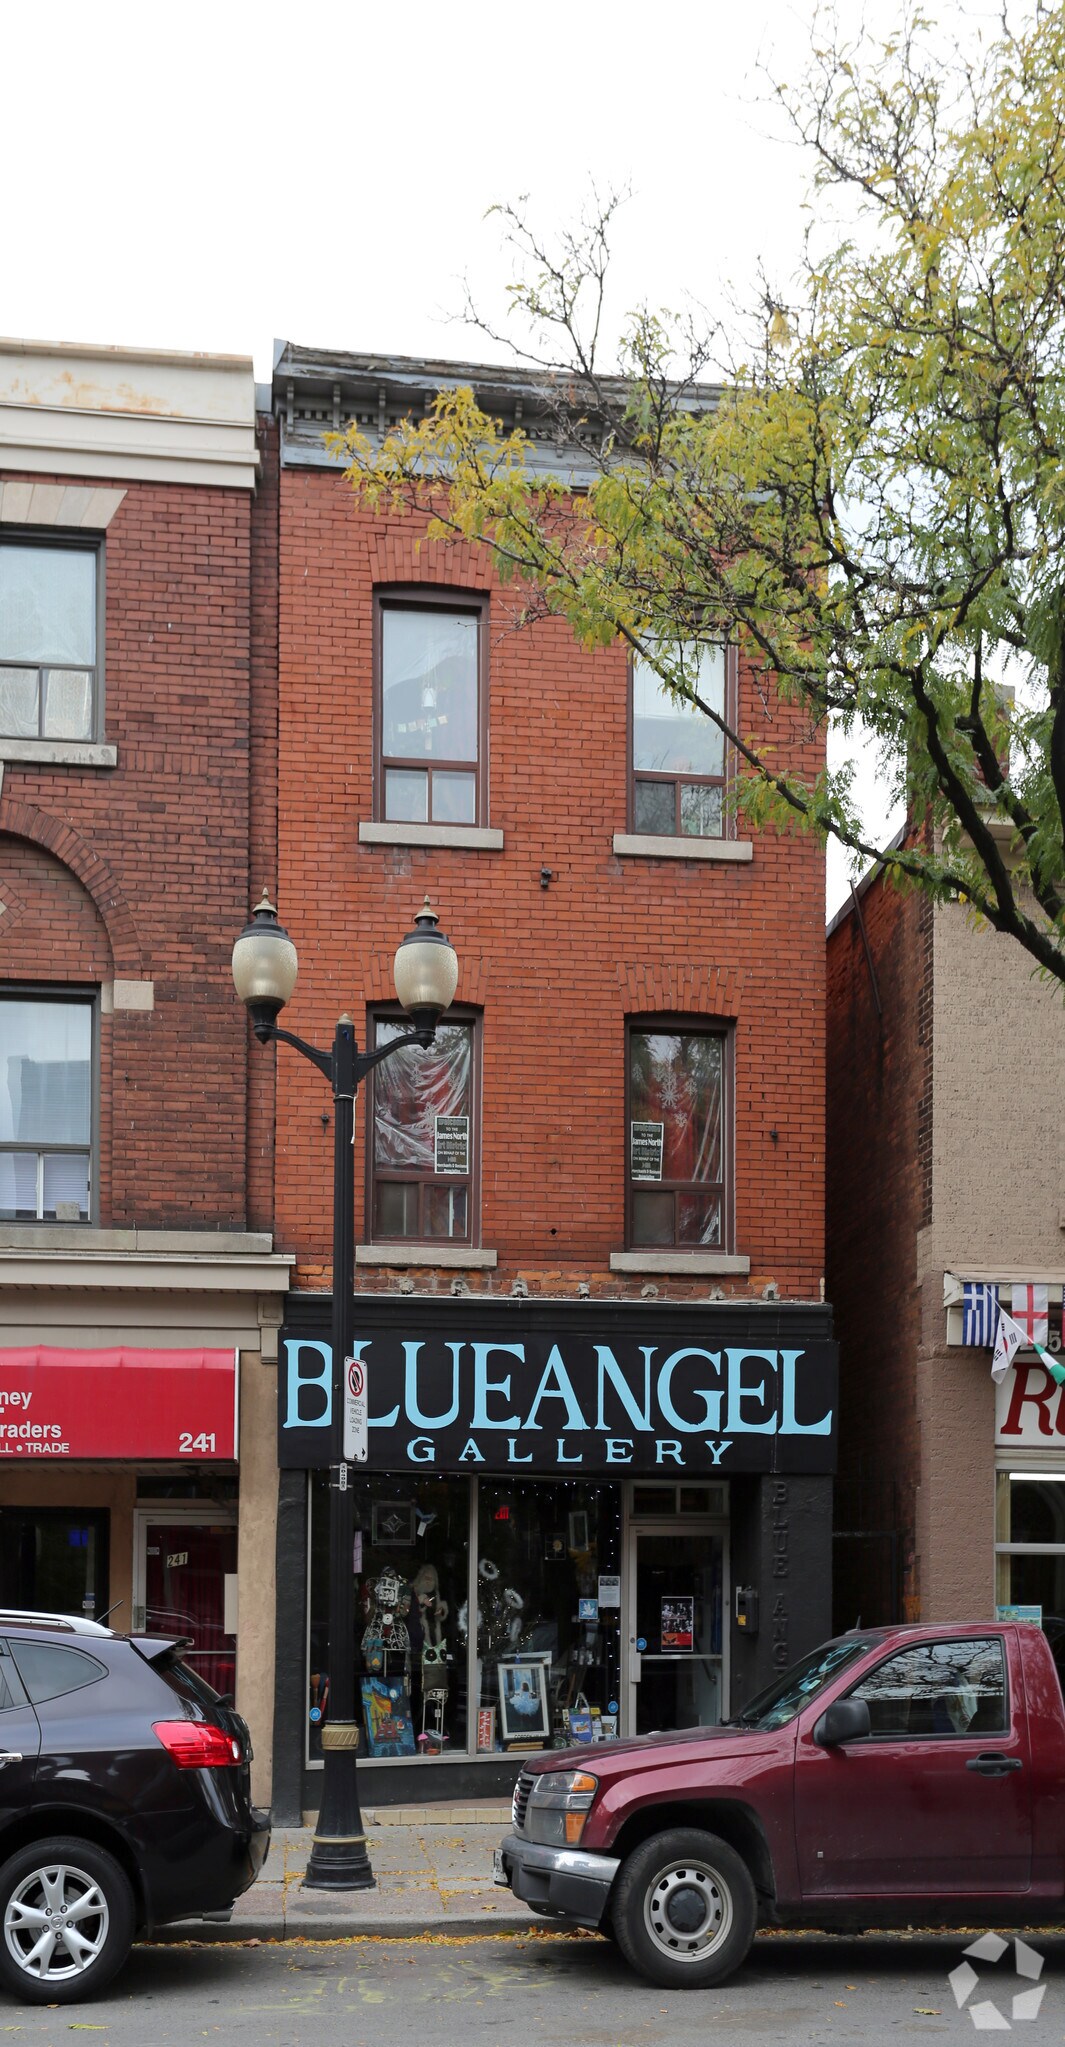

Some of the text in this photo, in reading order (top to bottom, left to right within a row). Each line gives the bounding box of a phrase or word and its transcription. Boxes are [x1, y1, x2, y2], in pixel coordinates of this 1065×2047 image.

[437, 1132, 467, 1141] James North
[632, 1138, 662, 1147] James North
[346, 1397, 366, 1408] COMMERCIAL
[1000, 1362, 1065, 1436] R
[350, 1407, 362, 1416] VEHICLE
[0, 1407, 62, 1438] raders
[349, 1416, 362, 1425] LOADING
[351, 1425, 360, 1434] ZONE
[25, 1442, 70, 1454] TRADE
[179, 1433, 216, 1453] 241
[407, 1436, 731, 1465] GALLERY
[773, 1481, 788, 1578] BLUE
[167, 1553, 187, 1567] 241
[773, 1593, 788, 1672] ANG
